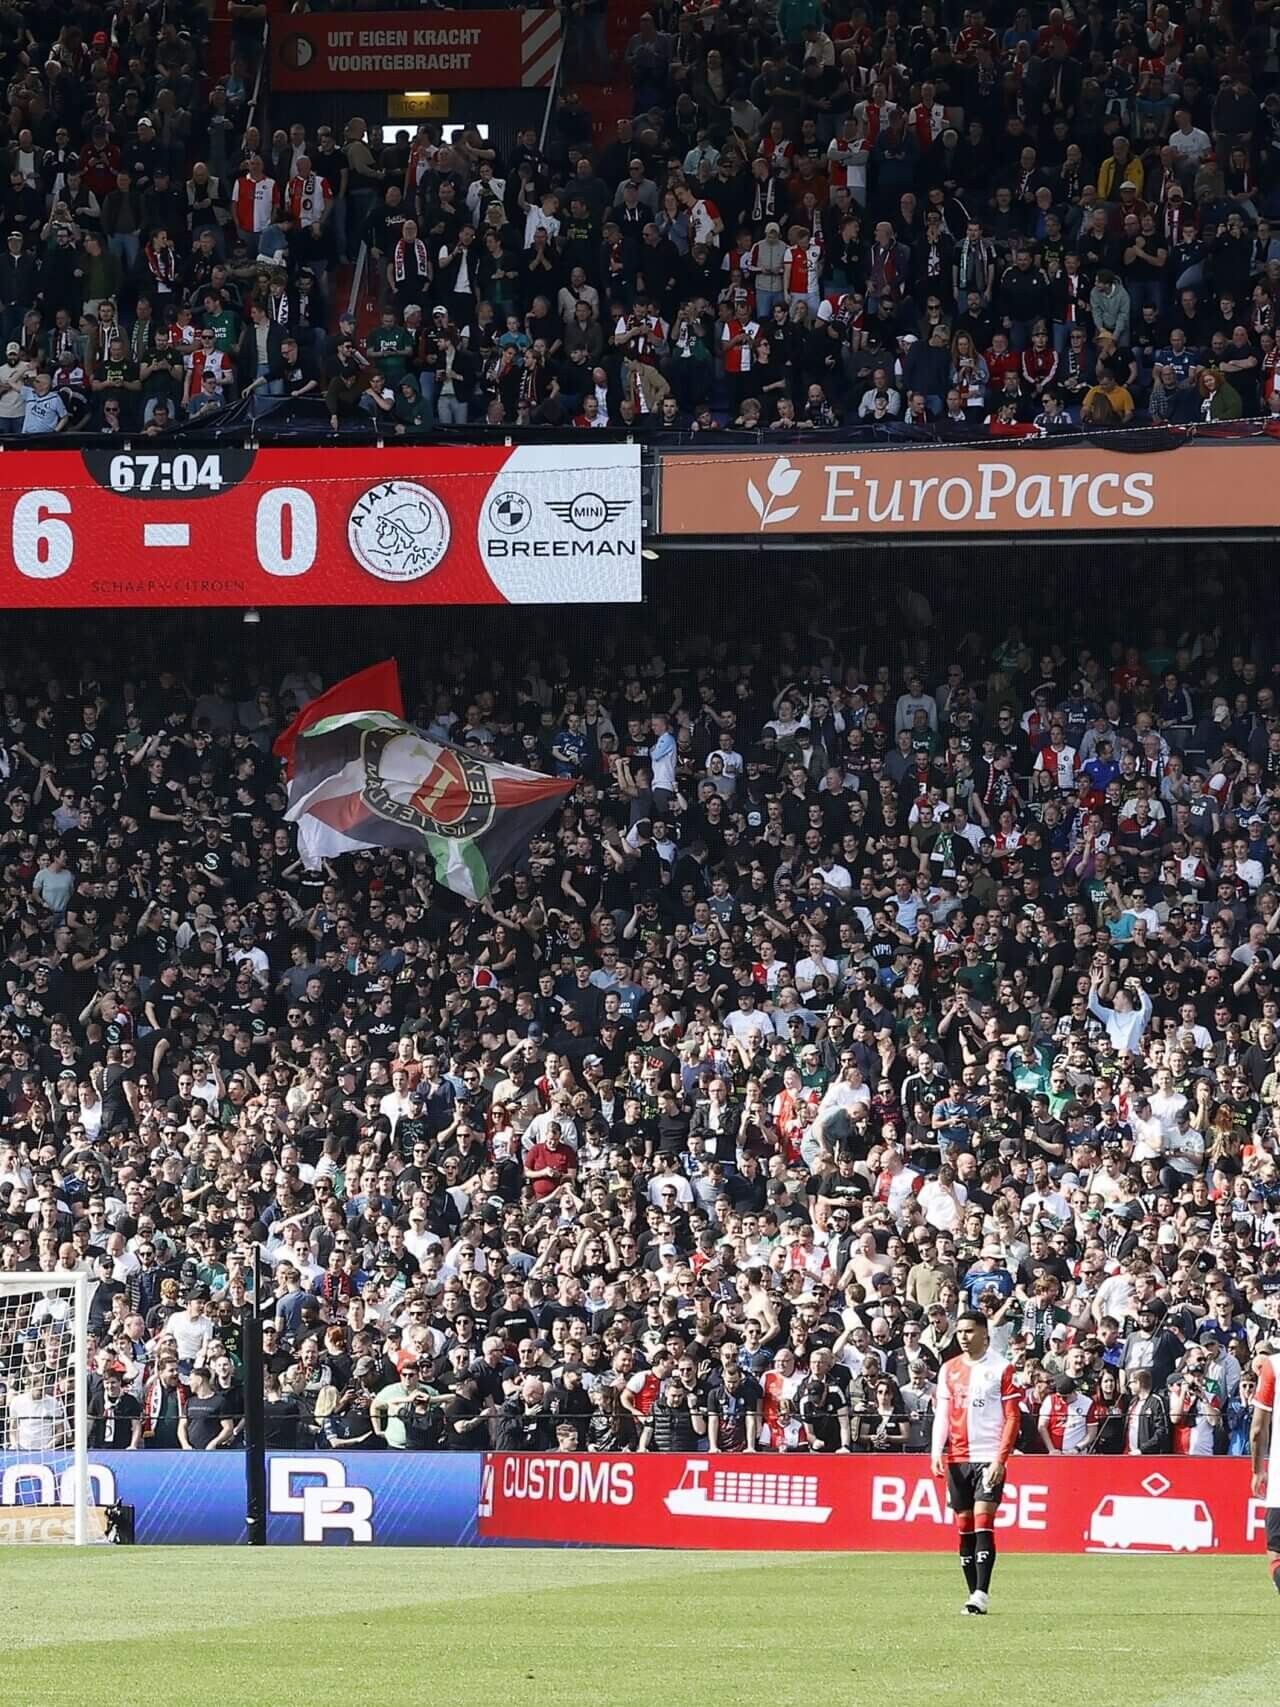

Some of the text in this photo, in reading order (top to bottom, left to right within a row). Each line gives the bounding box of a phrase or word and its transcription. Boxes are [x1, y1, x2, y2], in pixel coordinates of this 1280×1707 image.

[327, 28, 481, 47] UIT EIGEN KRACHT
[327, 53, 472, 71] VOORTGEBRACHT
[110, 454, 223, 491] 67:04
[820, 462, 1155, 523] EuroParcs
[351, 482, 397, 528] AJAX
[574, 507, 604, 518] MINI
[12, 489, 74, 579] 6
[256, 486, 318, 577] 0
[487, 539, 636, 558] BREEMAN
[503, 1456, 634, 1506] CUSTOMS
[871, 1475, 1049, 1530] BAGE
